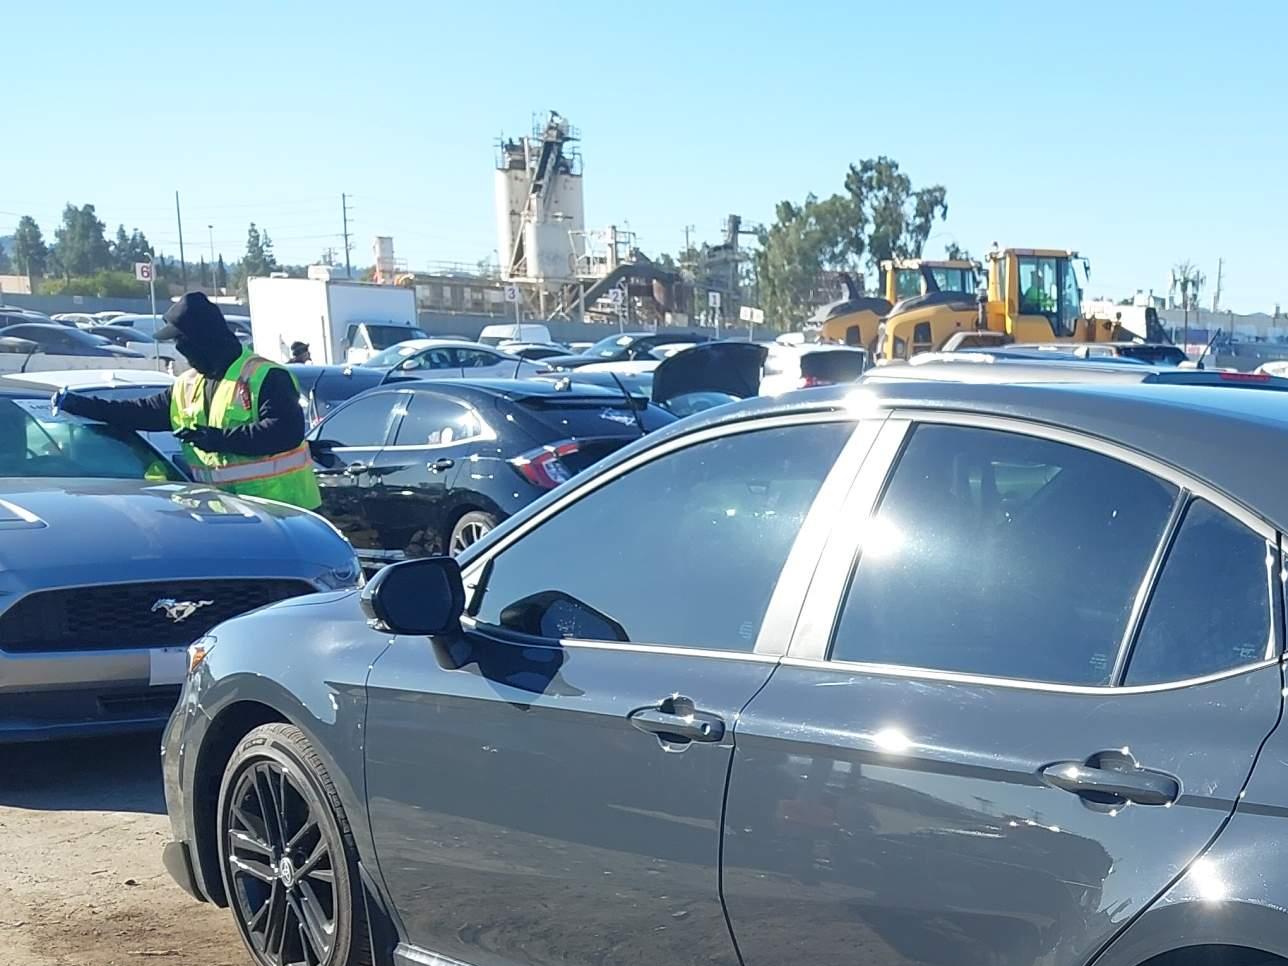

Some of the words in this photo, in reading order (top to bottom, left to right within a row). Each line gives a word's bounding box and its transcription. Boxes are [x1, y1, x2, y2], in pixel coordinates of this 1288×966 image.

[141, 265, 150, 279] 6
[507, 287, 516, 300] 3
[612, 290, 620, 302] 2
